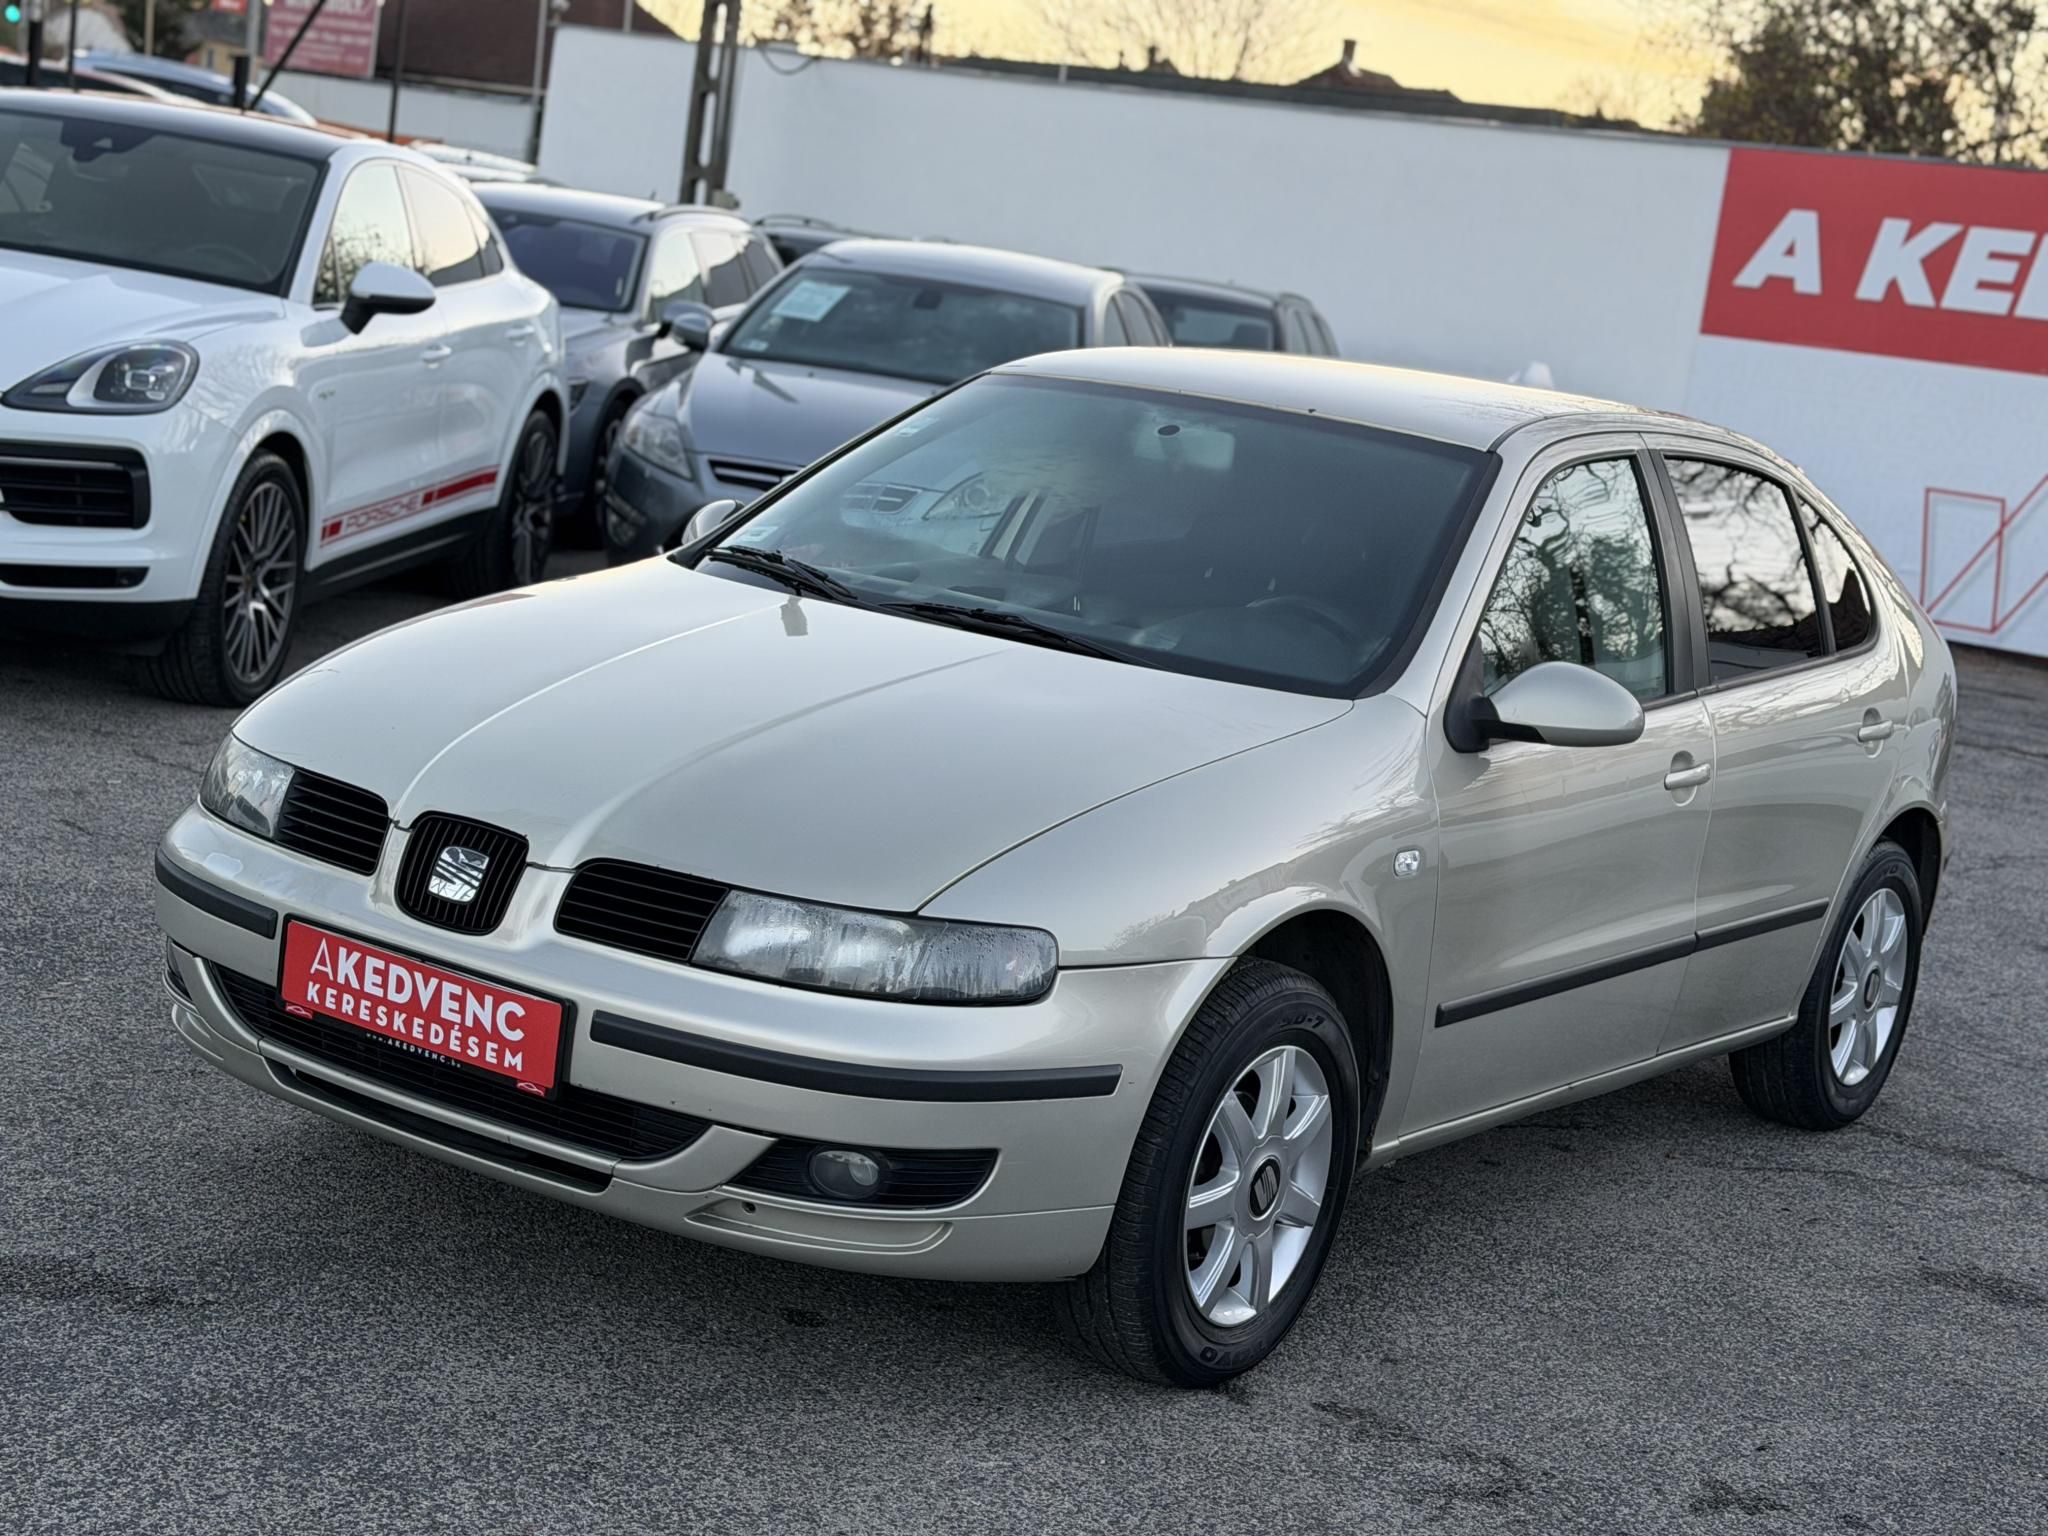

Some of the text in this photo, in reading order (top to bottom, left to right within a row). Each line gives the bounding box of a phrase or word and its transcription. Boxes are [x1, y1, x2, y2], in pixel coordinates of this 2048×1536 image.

[1732, 208, 1823, 296] A
[345, 495, 419, 529] PORSCHE
[306, 981, 523, 1072] KERESKEDÉSEM
[310, 937, 526, 1042] AKEDVENC
